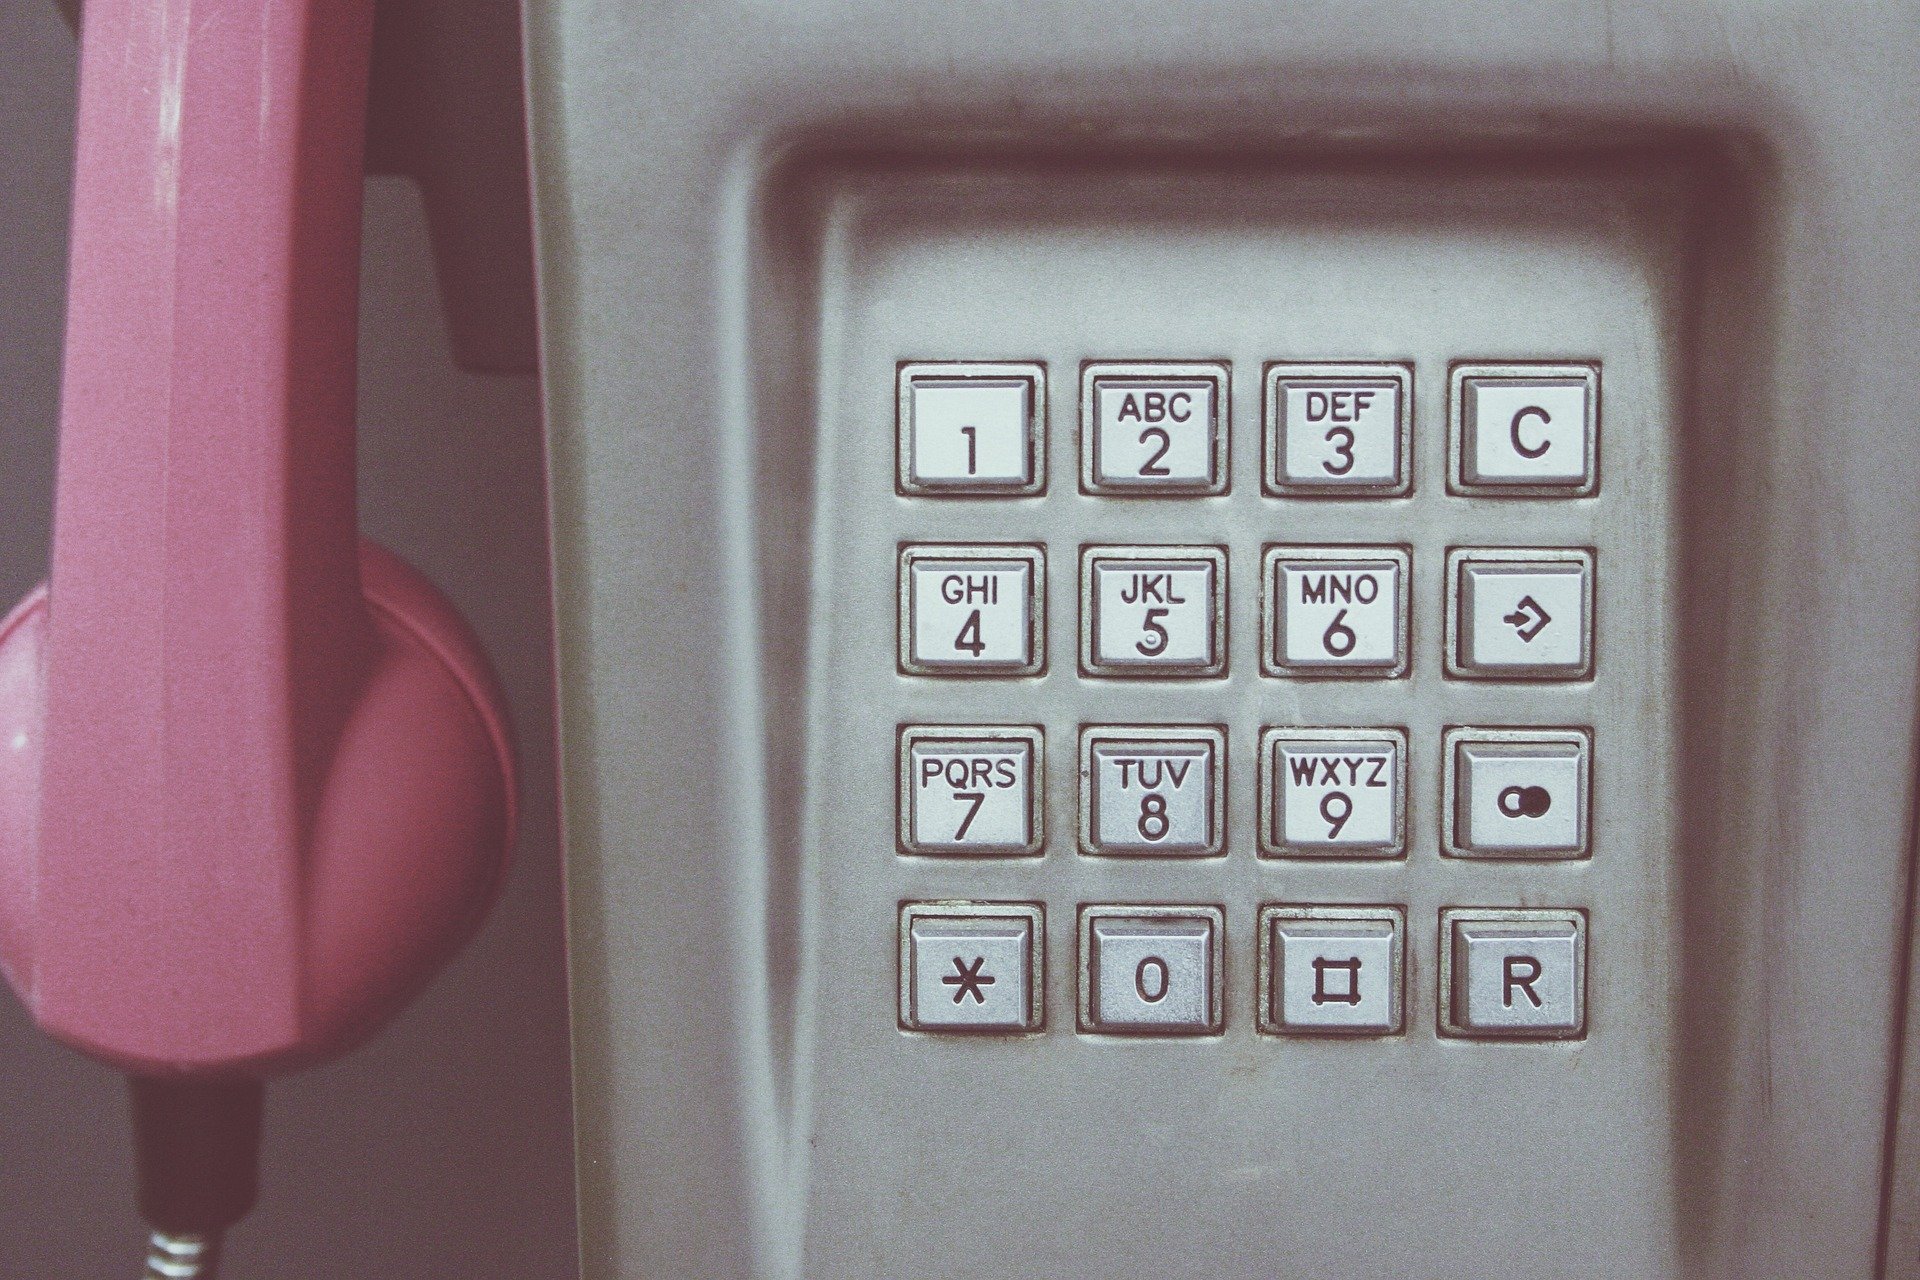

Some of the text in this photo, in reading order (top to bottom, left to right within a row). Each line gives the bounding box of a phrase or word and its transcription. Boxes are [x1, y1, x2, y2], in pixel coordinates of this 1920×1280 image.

[1117, 391, 1192, 423] ABC
[1306, 391, 1376, 422] DEF
[960, 425, 977, 476] 1
[1138, 426, 1171, 476] 2
[1322, 425, 1355, 476] 3
[1510, 405, 1552, 460] C
[940, 574, 998, 605] GHI
[1120, 573, 1186, 605] JKL
[1301, 574, 1379, 605] MNO
[953, 608, 986, 658] 4
[1135, 607, 1170, 657] 5
[1322, 608, 1357, 658] 6
[921, 758, 1017, 791] PQRS
[1113, 758, 1191, 790] TUV
[1289, 756, 1388, 788] WXYZ
[952, 791, 986, 841] 7
[1137, 792, 1170, 842] 8
[1319, 790, 1354, 840] 9
[1134, 954, 1172, 1003] 0
[1503, 954, 1543, 1008] R
